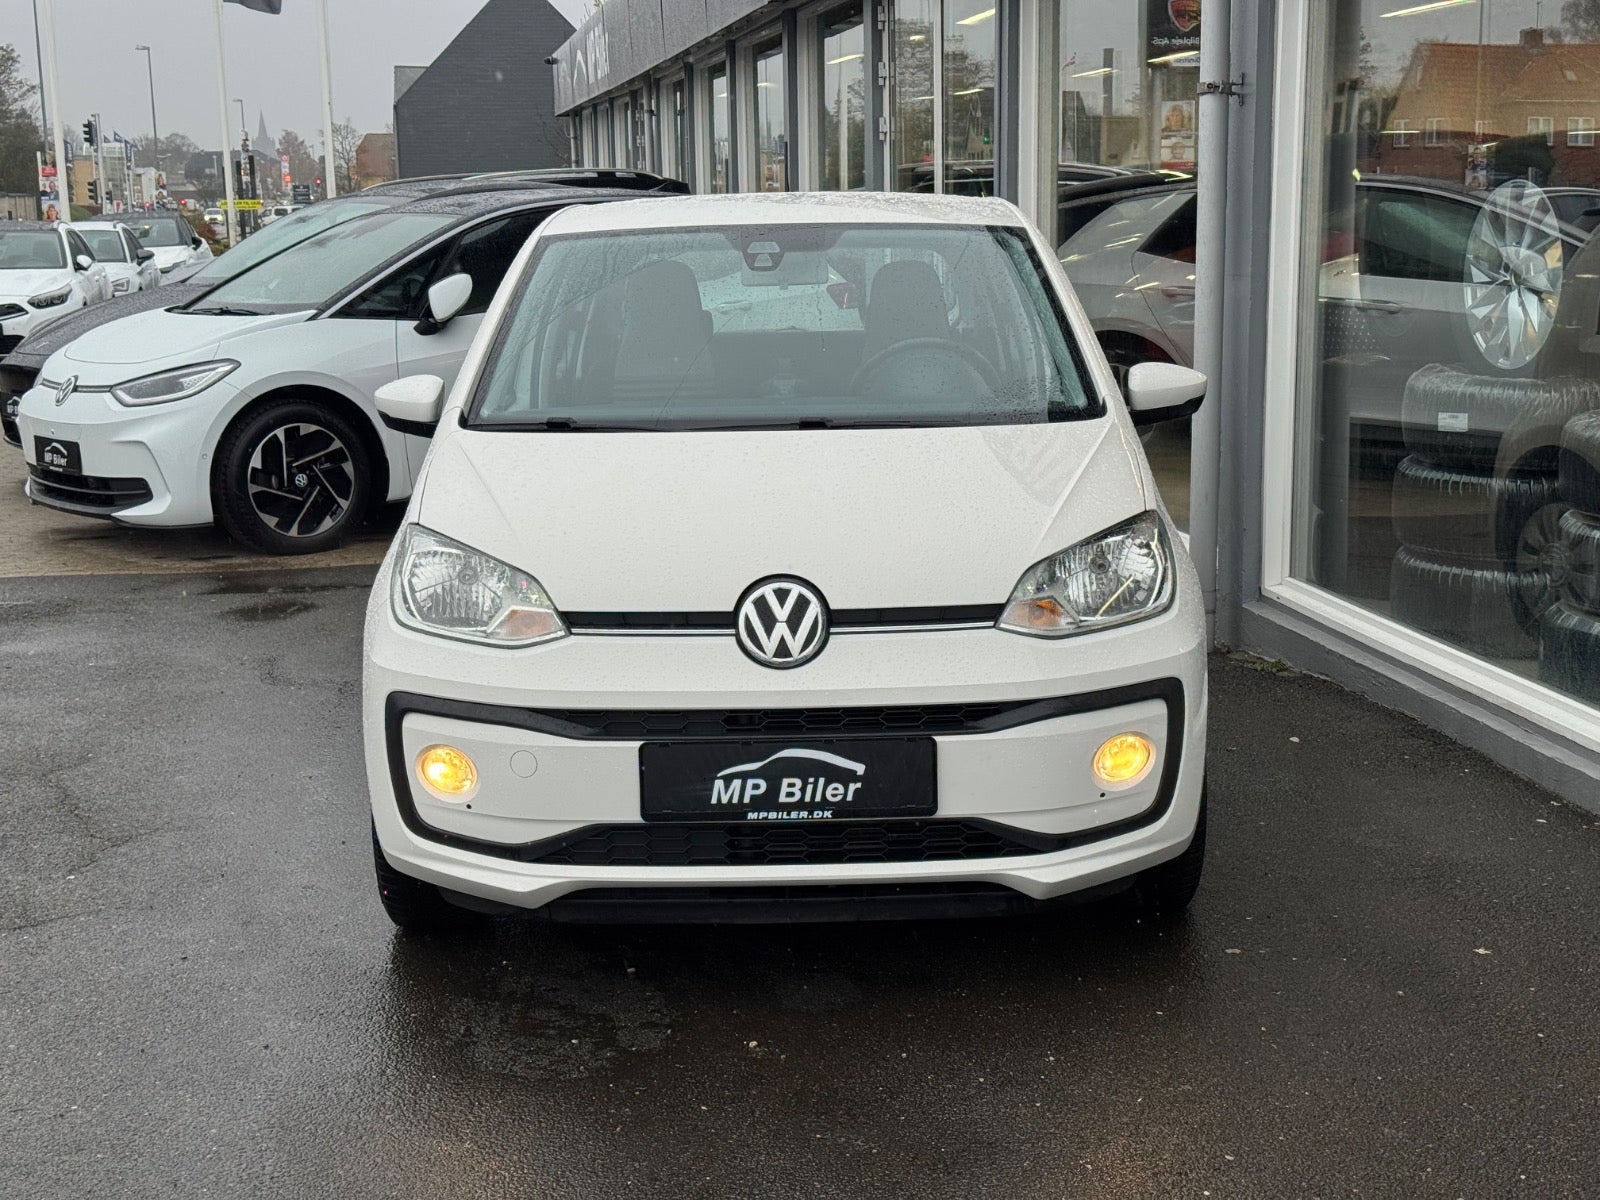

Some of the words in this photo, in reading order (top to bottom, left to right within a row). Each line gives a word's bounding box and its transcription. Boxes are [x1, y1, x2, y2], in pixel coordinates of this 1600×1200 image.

[710, 778, 767, 804] MP
[778, 777, 863, 804] Biler
[747, 809, 833, 821] MPBILER.DK
